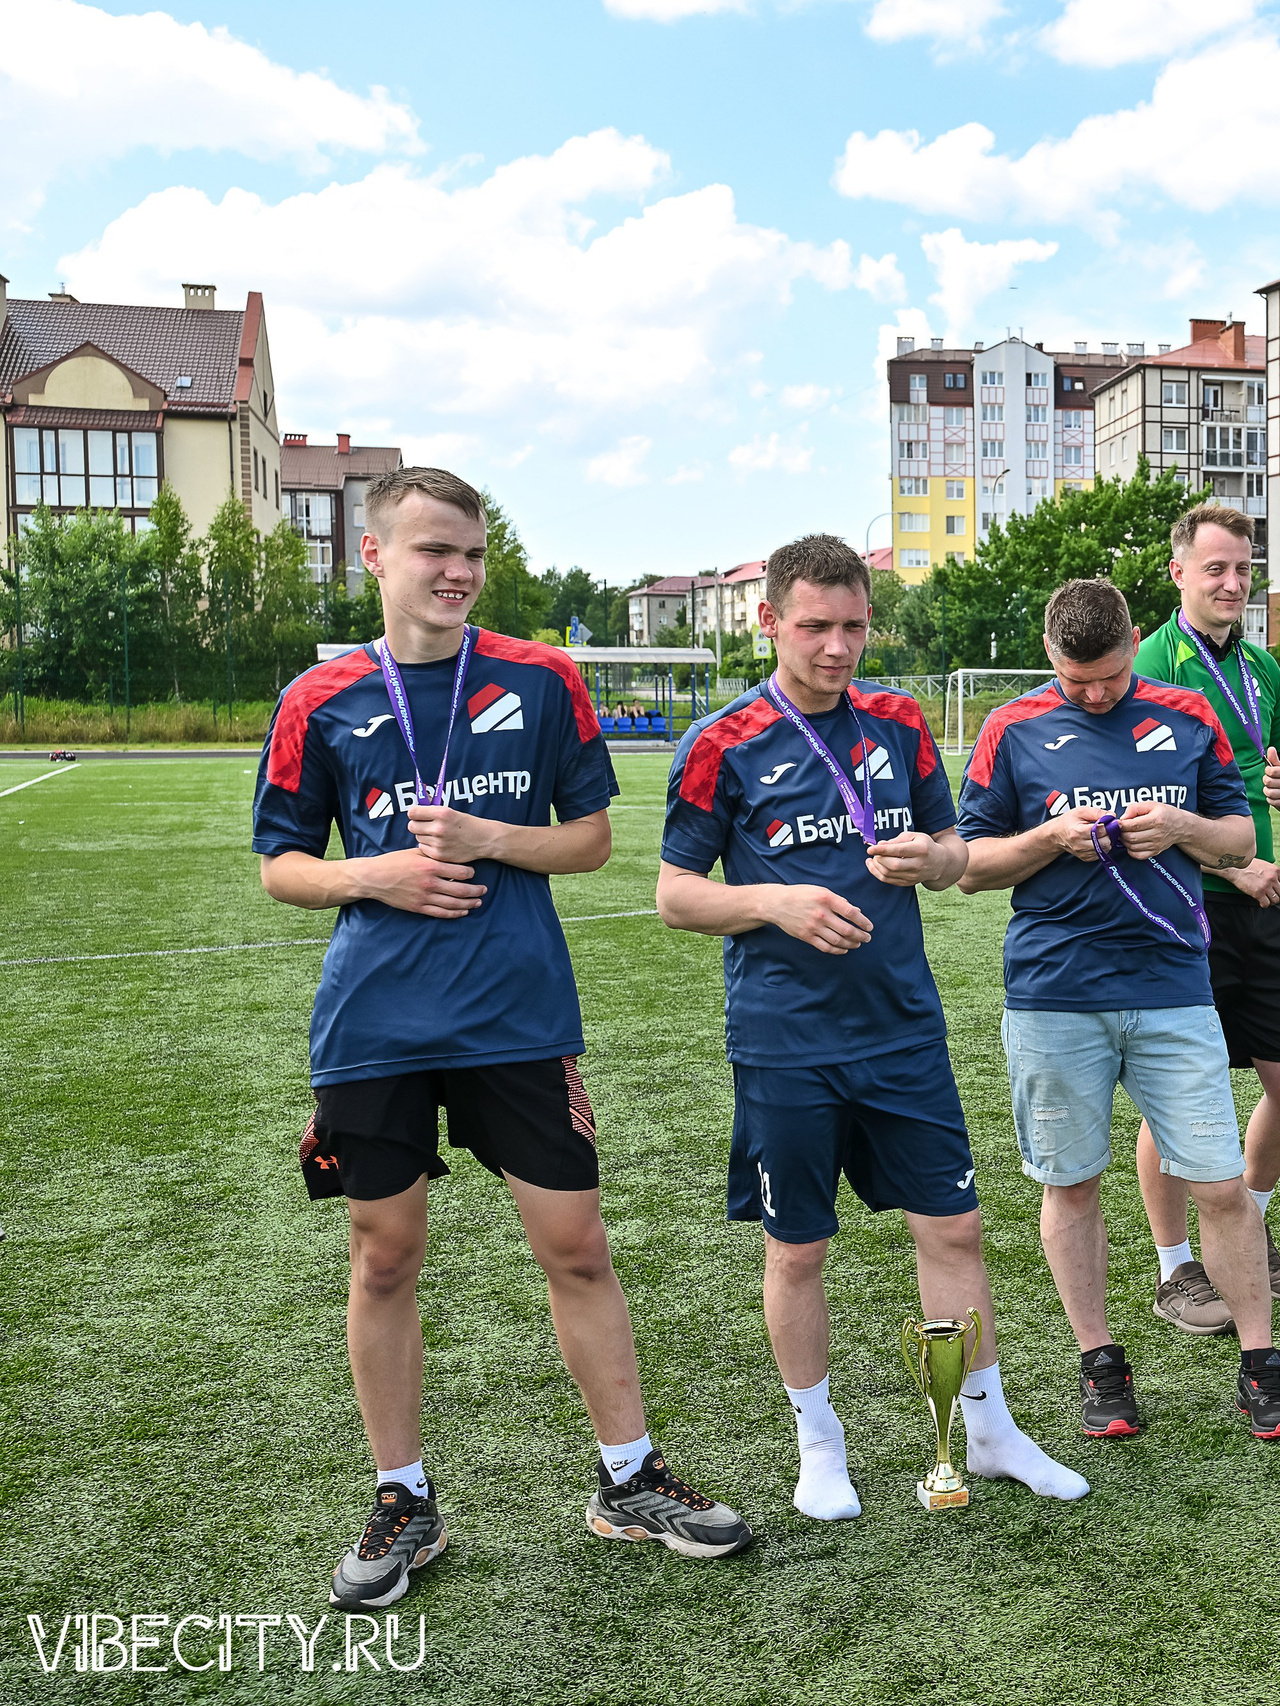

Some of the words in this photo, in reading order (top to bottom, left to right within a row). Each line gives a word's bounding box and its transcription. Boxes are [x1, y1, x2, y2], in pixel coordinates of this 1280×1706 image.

[1216, 674, 1249, 725] Региональный
[786, 707, 827, 759] отборочный
[824, 755, 840, 777] этап
[1073, 784, 1188, 813] Бауцентр
[1153, 863, 1196, 908] Региональный
